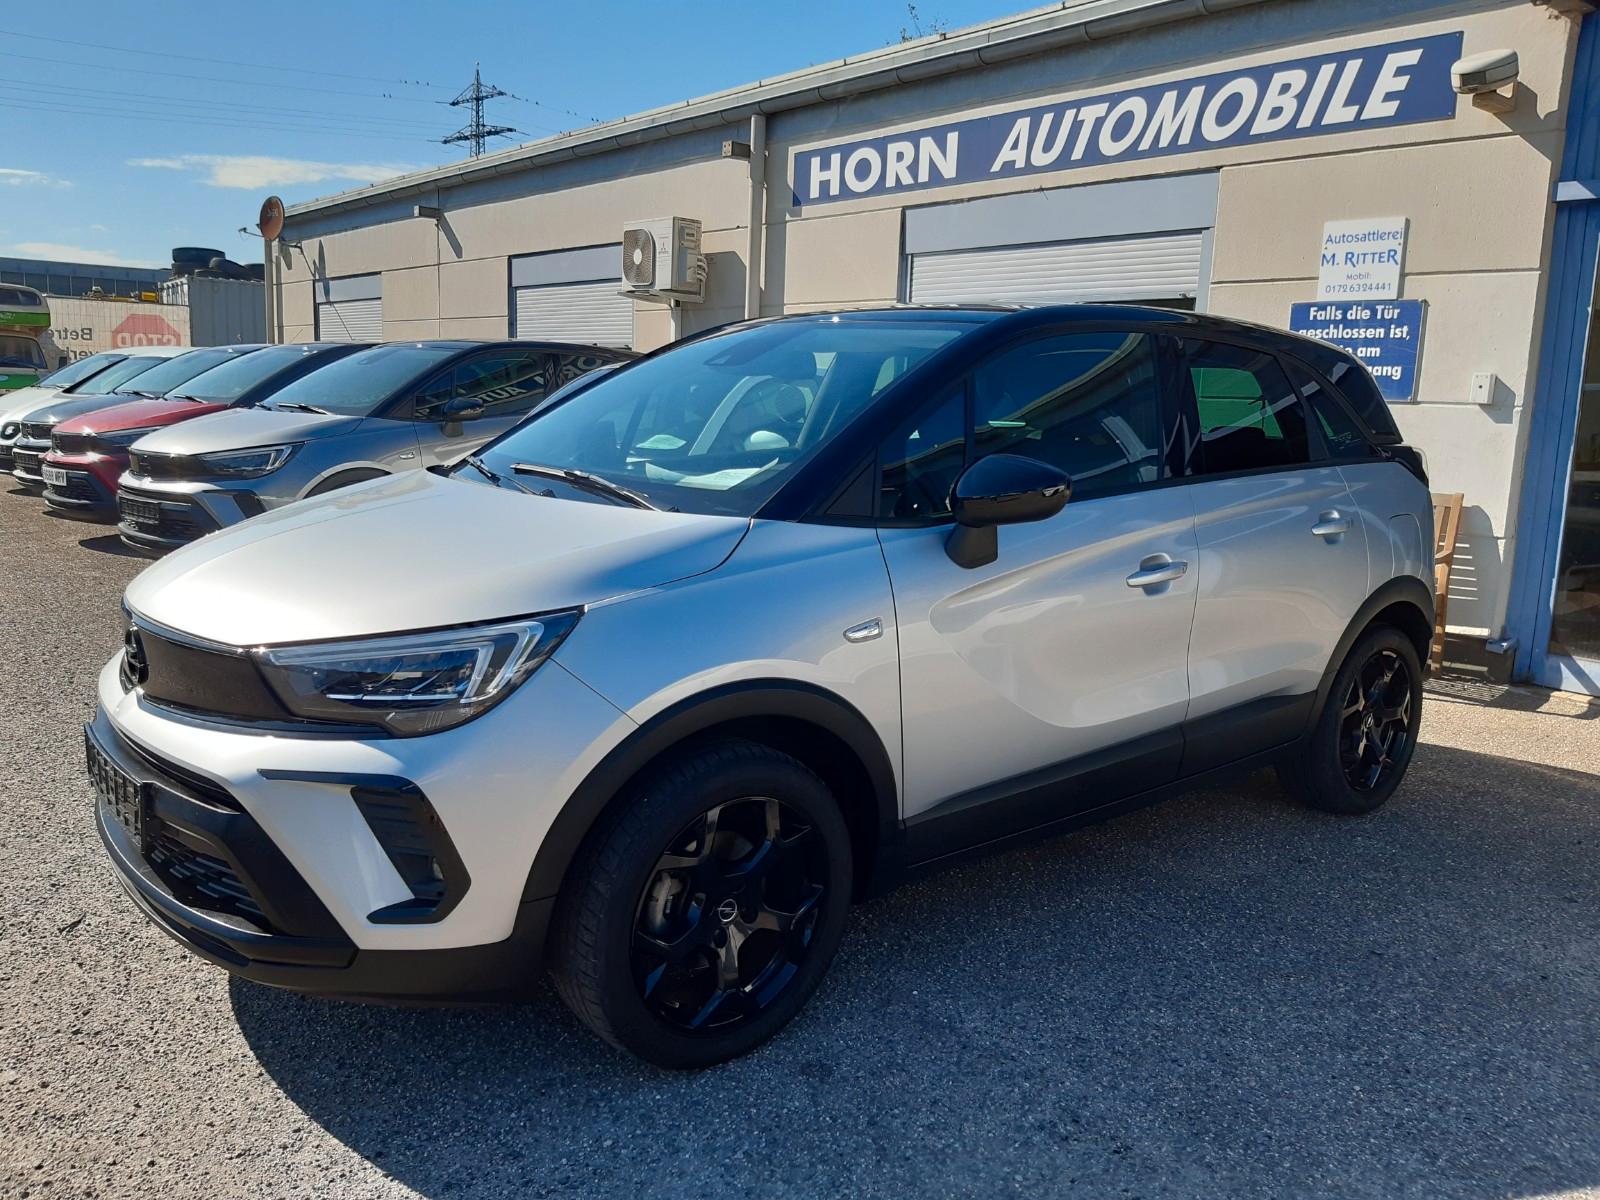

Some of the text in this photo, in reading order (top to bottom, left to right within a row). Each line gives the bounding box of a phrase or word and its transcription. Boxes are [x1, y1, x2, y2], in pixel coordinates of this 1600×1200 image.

[810, 49, 1423, 199] HORN AUTOMOBILE
[1325, 228, 1403, 245] Autosattlerei
[1321, 248, 1399, 268] M. RITTER
[1309, 305, 1400, 320] Falls die Tür
[1389, 324, 1410, 341] ist,
[1357, 346, 1380, 357] am
